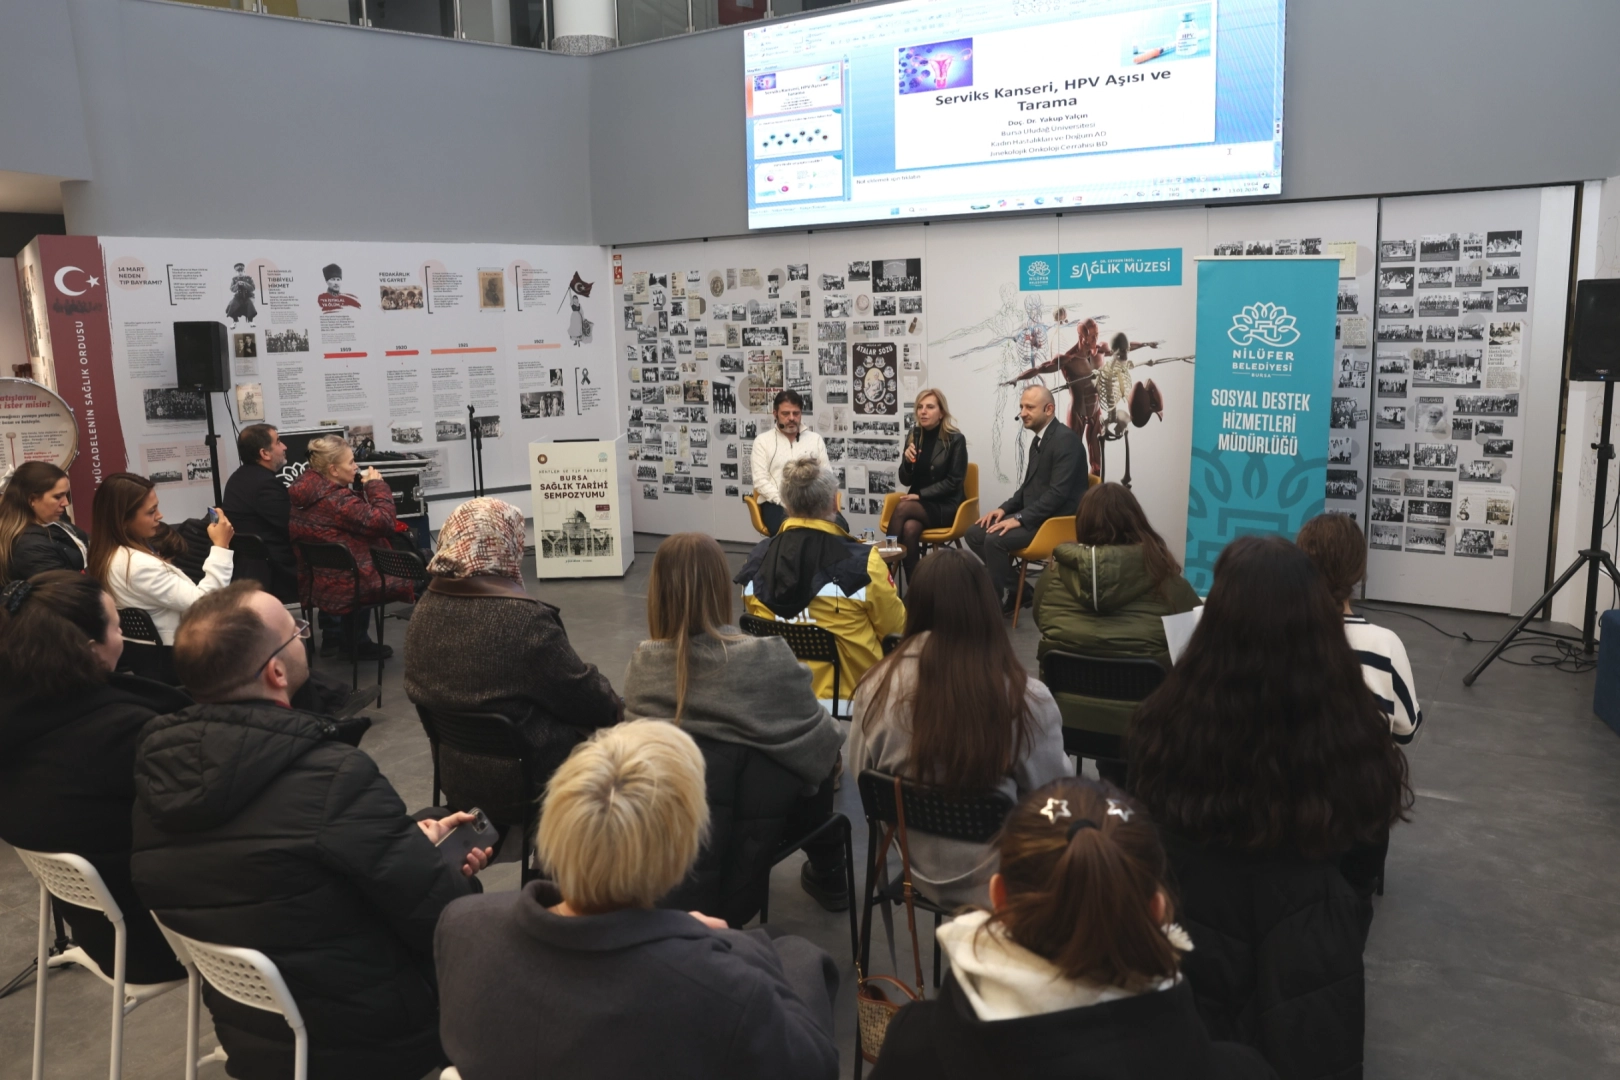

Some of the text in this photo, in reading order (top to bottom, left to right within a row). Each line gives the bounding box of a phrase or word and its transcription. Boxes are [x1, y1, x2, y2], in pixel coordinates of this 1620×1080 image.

[935, 69, 1171, 106] Serviks Kanseri, HPV Aşısı ve
[1017, 97, 1077, 111] Tarama
[1040, 115, 1063, 123] Yakup
[1023, 126, 1050, 134] Uludağ
[1051, 122, 1096, 132] Üniversitesi
[1029, 144, 1060, 153] Onkoloji
[1070, 257, 1171, 282] SAĞLIK MÜZESİ
[1232, 347, 1294, 361] NİLÜFER
[1232, 361, 1292, 372] BELEDİYESİ
[75, 320, 102, 484] MÜCADELENİN SAĞLIK ORDUSU
[1211, 388, 1311, 412] SOSYAL DESTEK
[1222, 409, 1296, 433] HİZMETLERİ
[1218, 431, 1298, 456] MÜDÜRLÜĞÜ
[540, 481, 608, 491] SAĞLIK TARİHİ
[544, 491, 605, 500] SEMPOZYUMU
